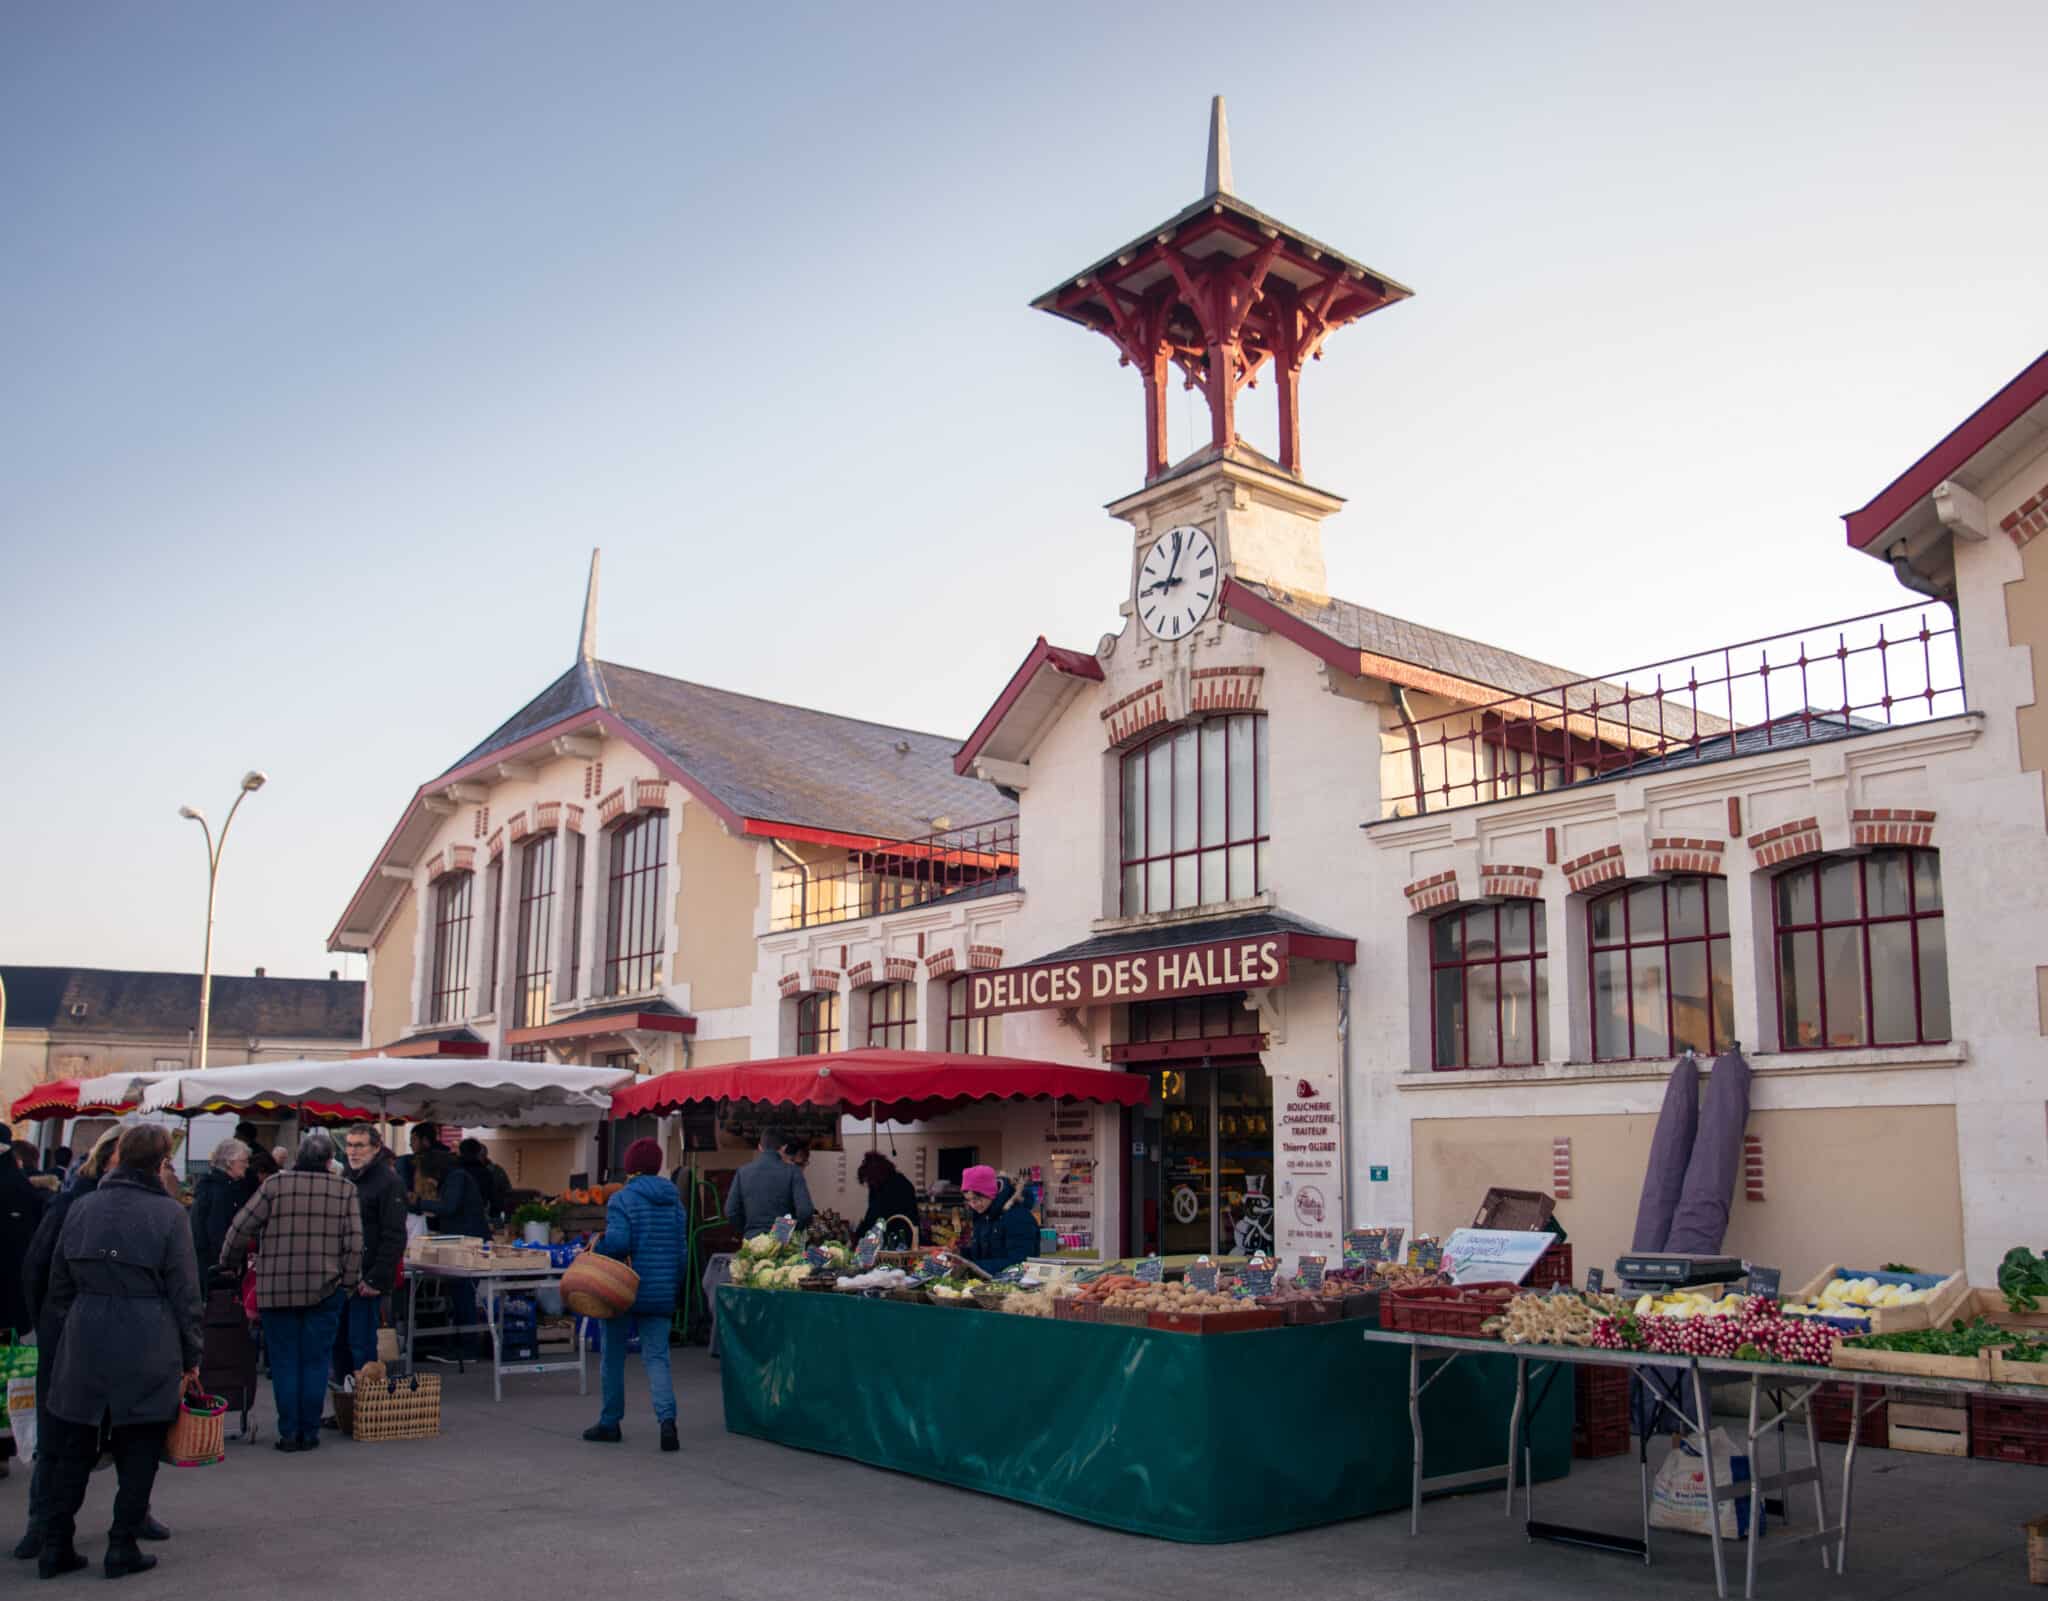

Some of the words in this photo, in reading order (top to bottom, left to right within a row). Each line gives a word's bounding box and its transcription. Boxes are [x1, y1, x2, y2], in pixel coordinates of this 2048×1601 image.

[974, 966, 1081, 1010] DELICES
[1092, 958, 1148, 998] DES
[1157, 942, 1280, 991] HALLES
[1286, 1102, 1332, 1112] BOUCHERIE
[1282, 1114, 1336, 1124] CHARCUTERIE
[1291, 1127, 1328, 1136] TRAITEUR
[1282, 1142, 1307, 1154] Thierry
